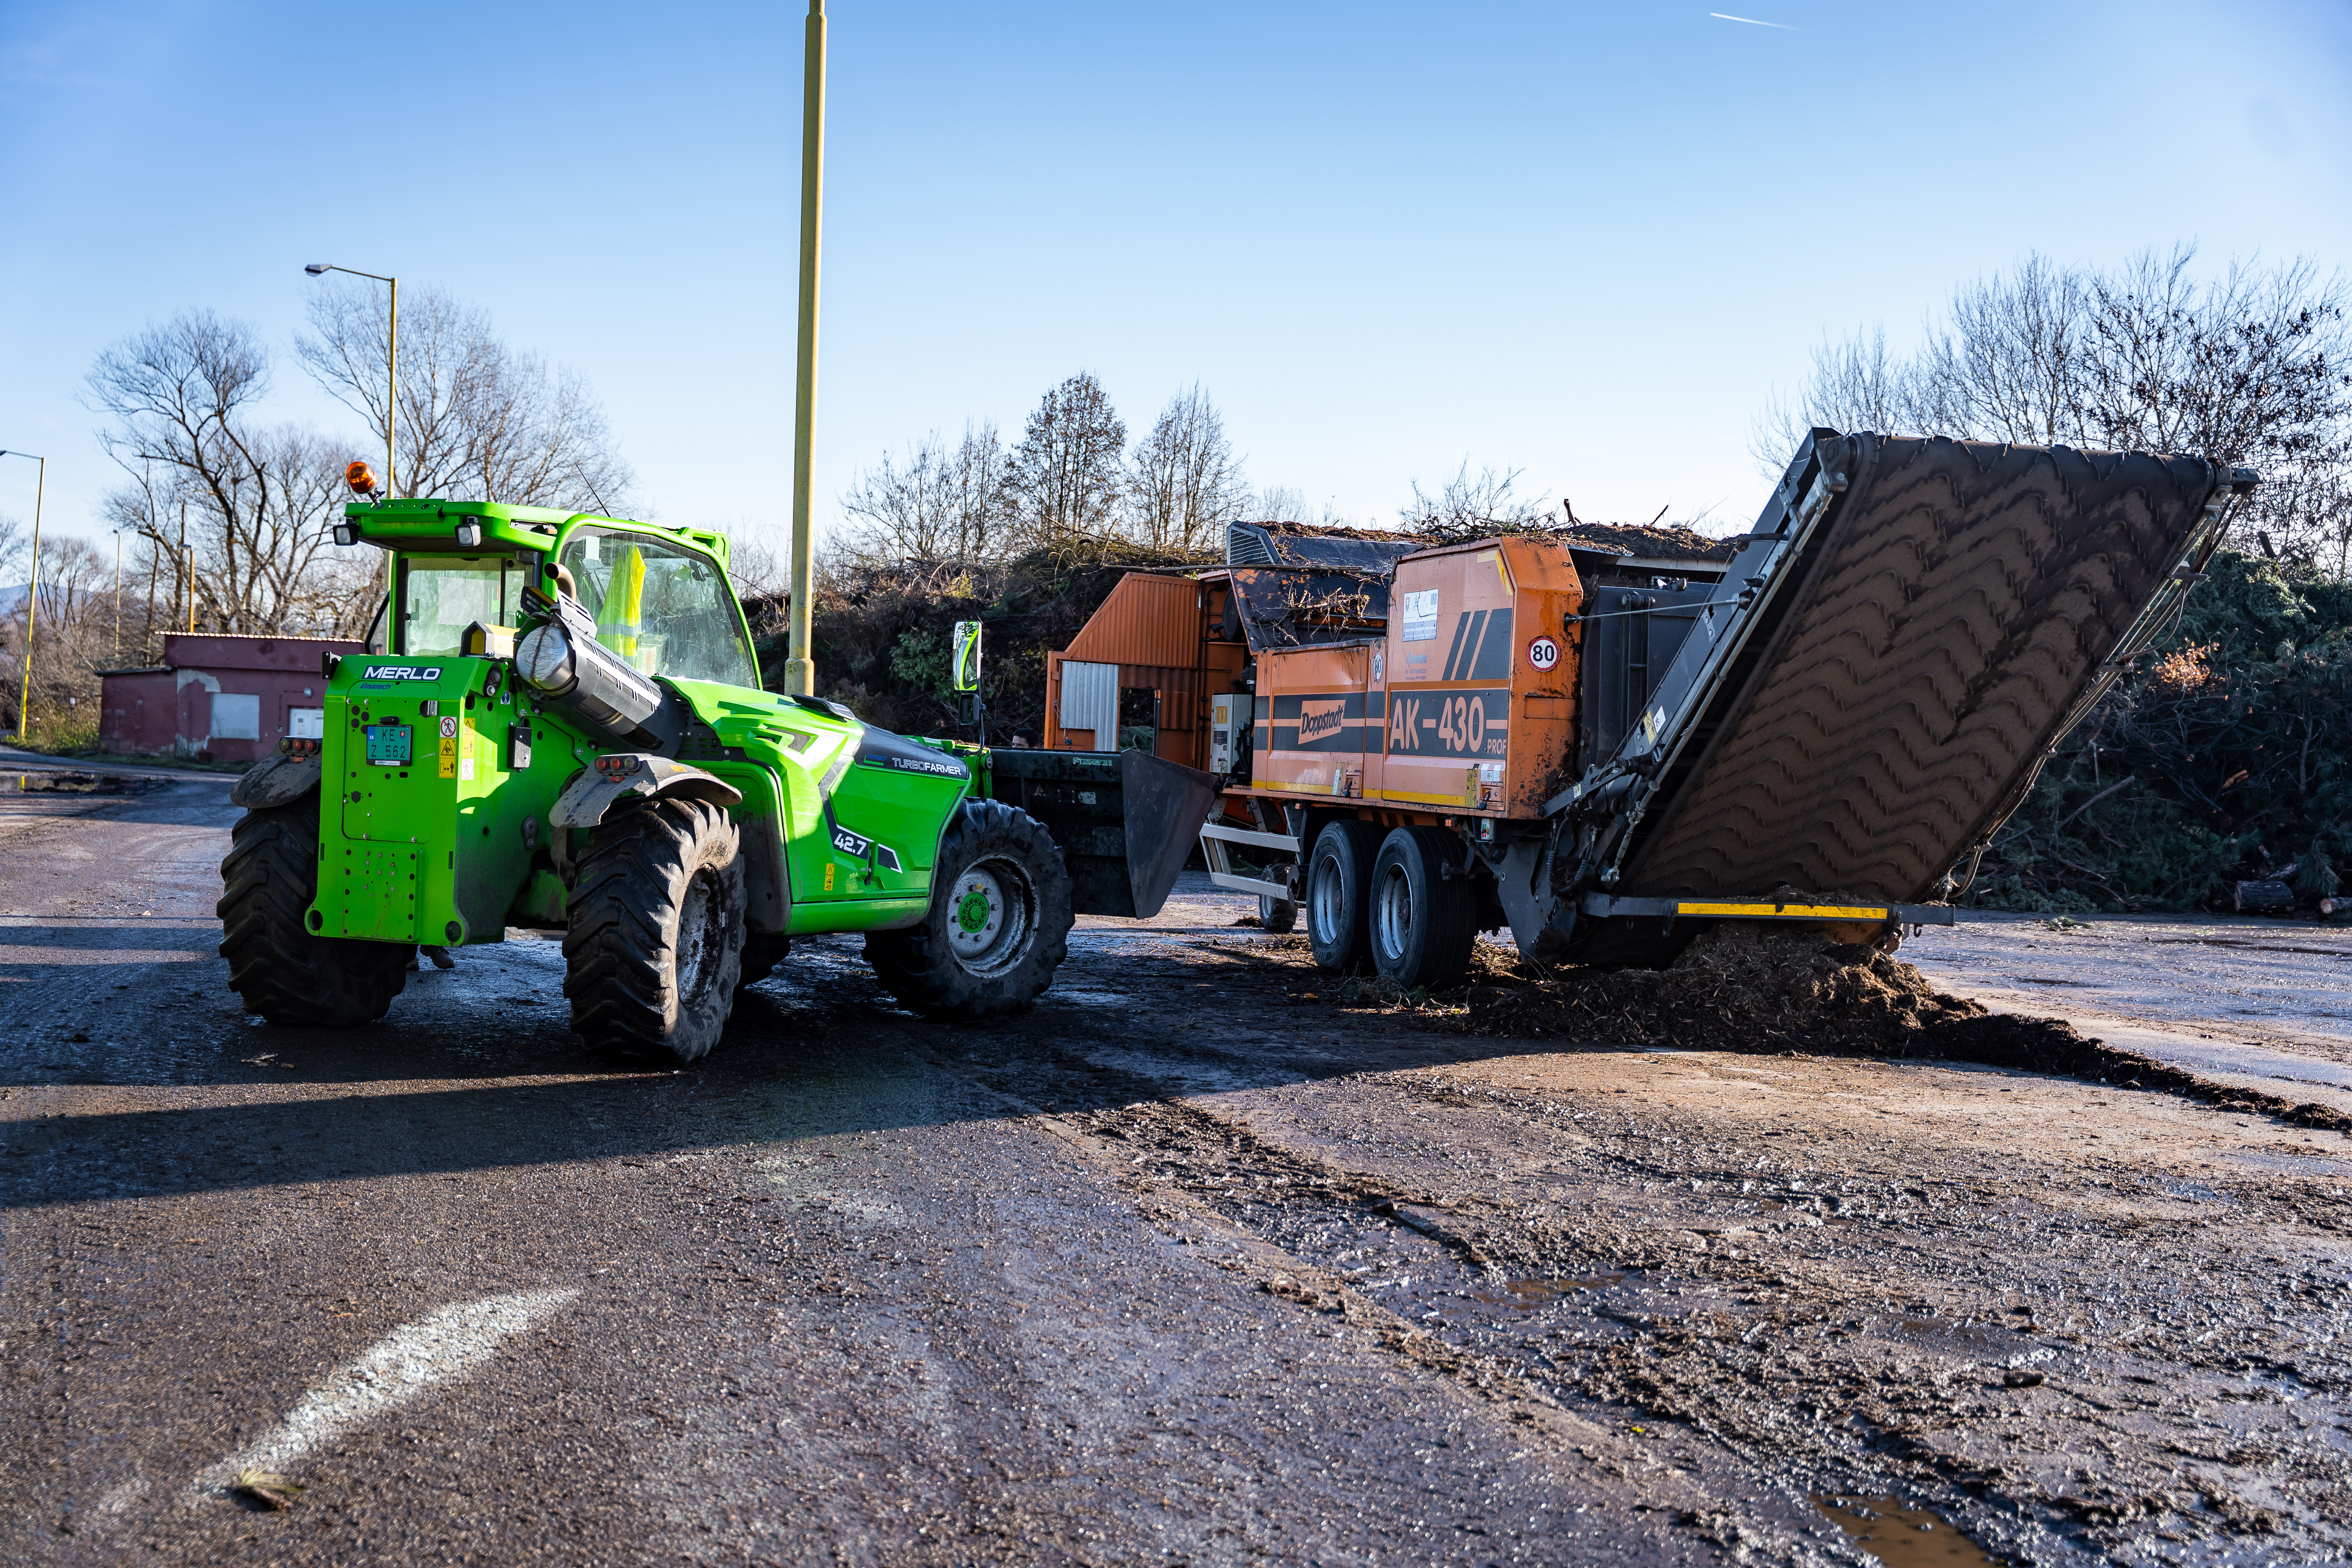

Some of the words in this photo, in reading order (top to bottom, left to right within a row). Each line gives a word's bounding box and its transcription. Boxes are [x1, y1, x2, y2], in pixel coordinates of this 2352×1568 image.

[1533, 645, 1554, 662] 80
[364, 666, 440, 680] MERLO
[1375, 659, 1381, 673] 80
[1301, 705, 1343, 736] Doppstadt
[382, 729, 395, 741] KE
[371, 745, 376, 757] Z
[386, 745, 405, 758] 562
[892, 757, 962, 775] TURBOFARMER
[834, 833, 867, 855] 42.7
